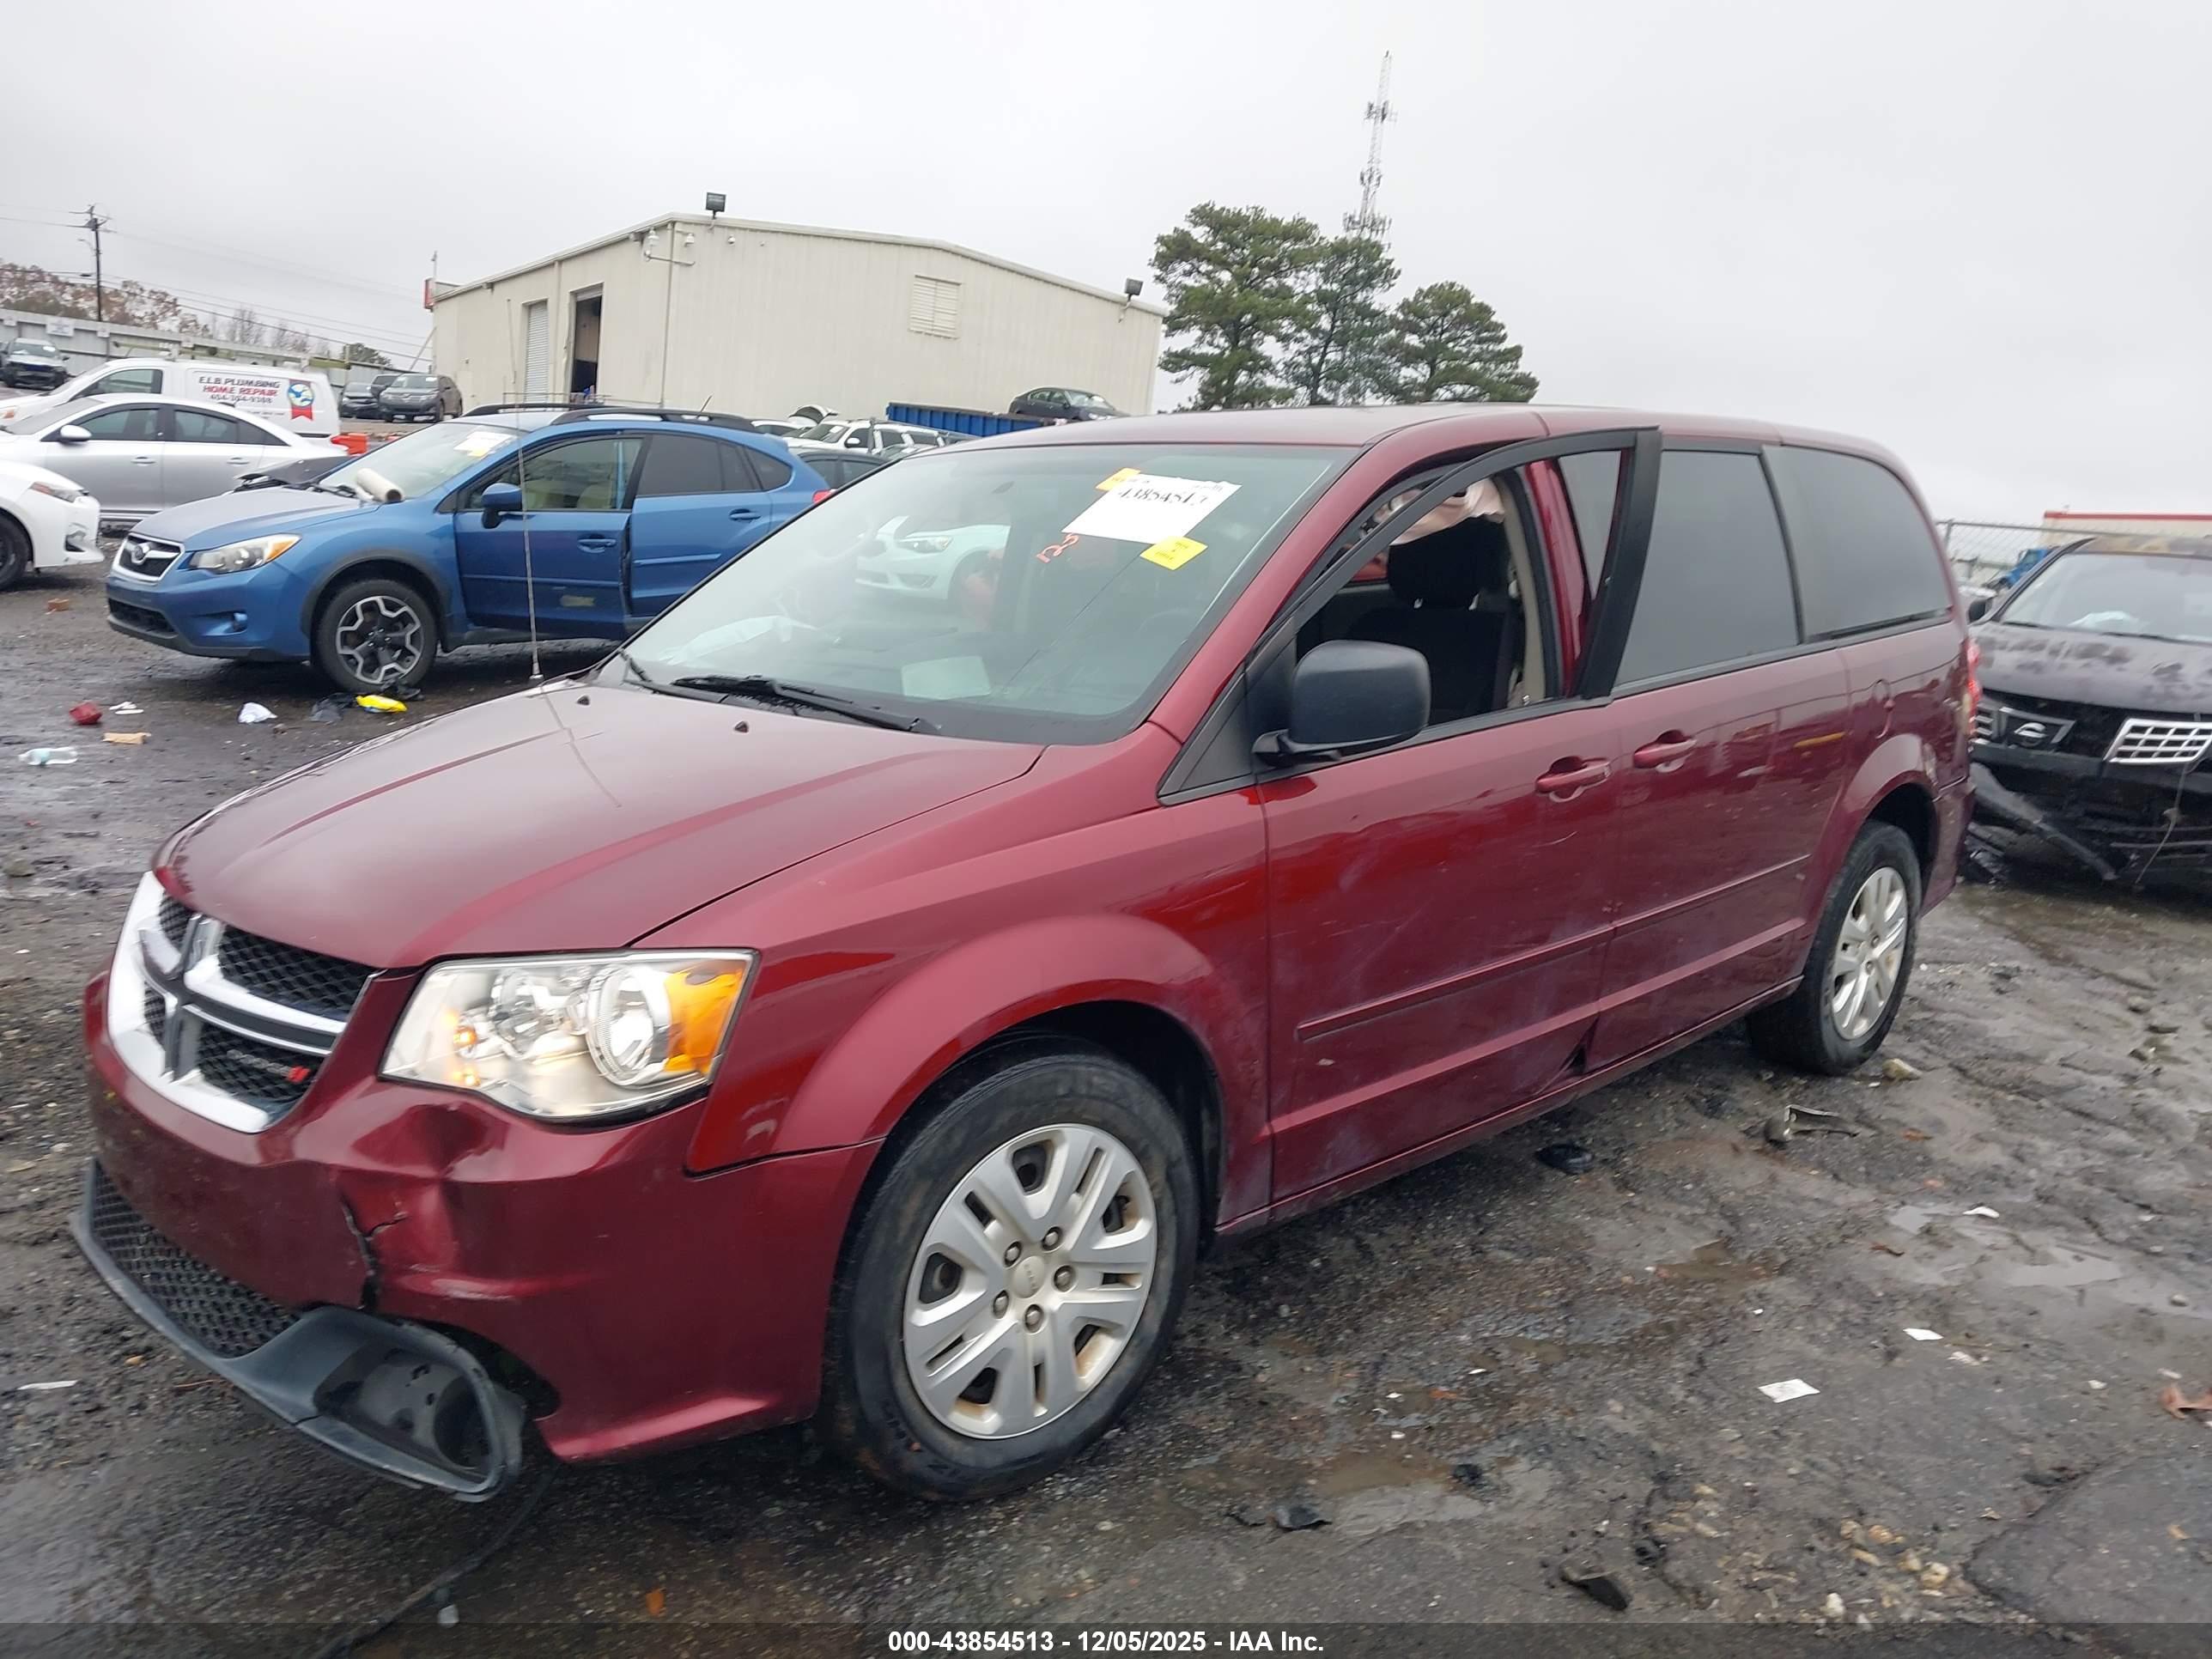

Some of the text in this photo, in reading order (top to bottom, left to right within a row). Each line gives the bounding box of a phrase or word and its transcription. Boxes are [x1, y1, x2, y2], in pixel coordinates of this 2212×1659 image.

[224, 378, 282, 388] PLUMBING
[203, 386, 279, 397] HOME REPAIR
